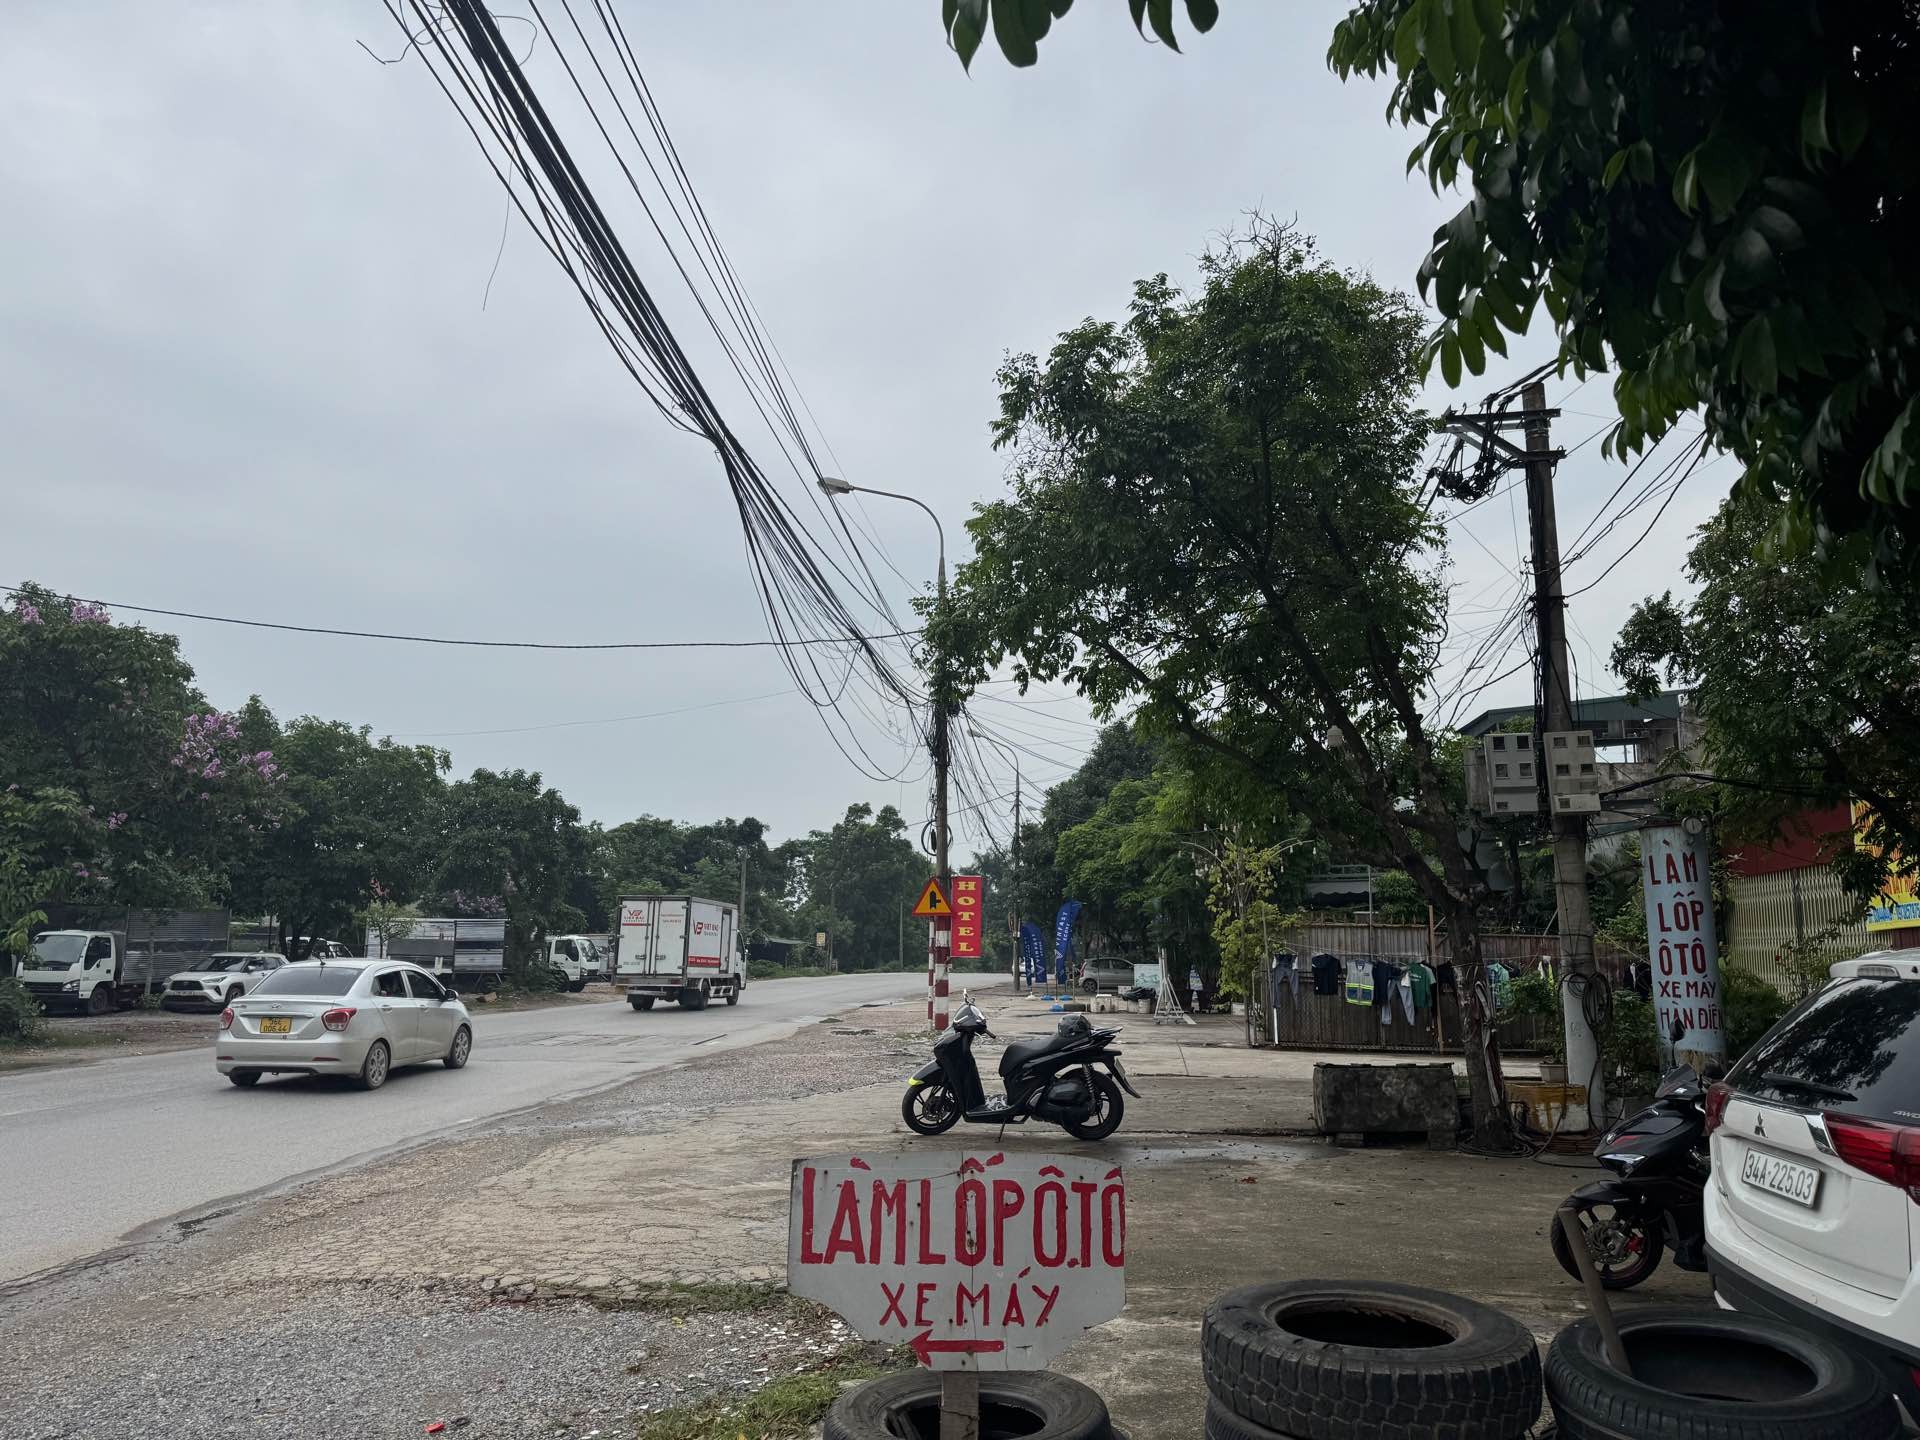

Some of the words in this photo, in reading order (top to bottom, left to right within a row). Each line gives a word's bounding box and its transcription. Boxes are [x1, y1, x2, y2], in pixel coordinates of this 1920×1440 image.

[1649, 839, 1699, 885] LÀM
[957, 881, 977, 952] HOTEL
[1657, 890, 1704, 932] LỐP
[1658, 937, 1707, 976] ÔTÔ
[1658, 980, 1682, 998] XE
[1686, 974, 1717, 998] MÁY
[1659, 1000, 1695, 1031] HÀN
[801, 1157, 907, 1265] LÀM
[918, 1152, 1025, 1267] LỐP
[879, 1282, 937, 1328] XE
[955, 1266, 1060, 1328] MÁY
